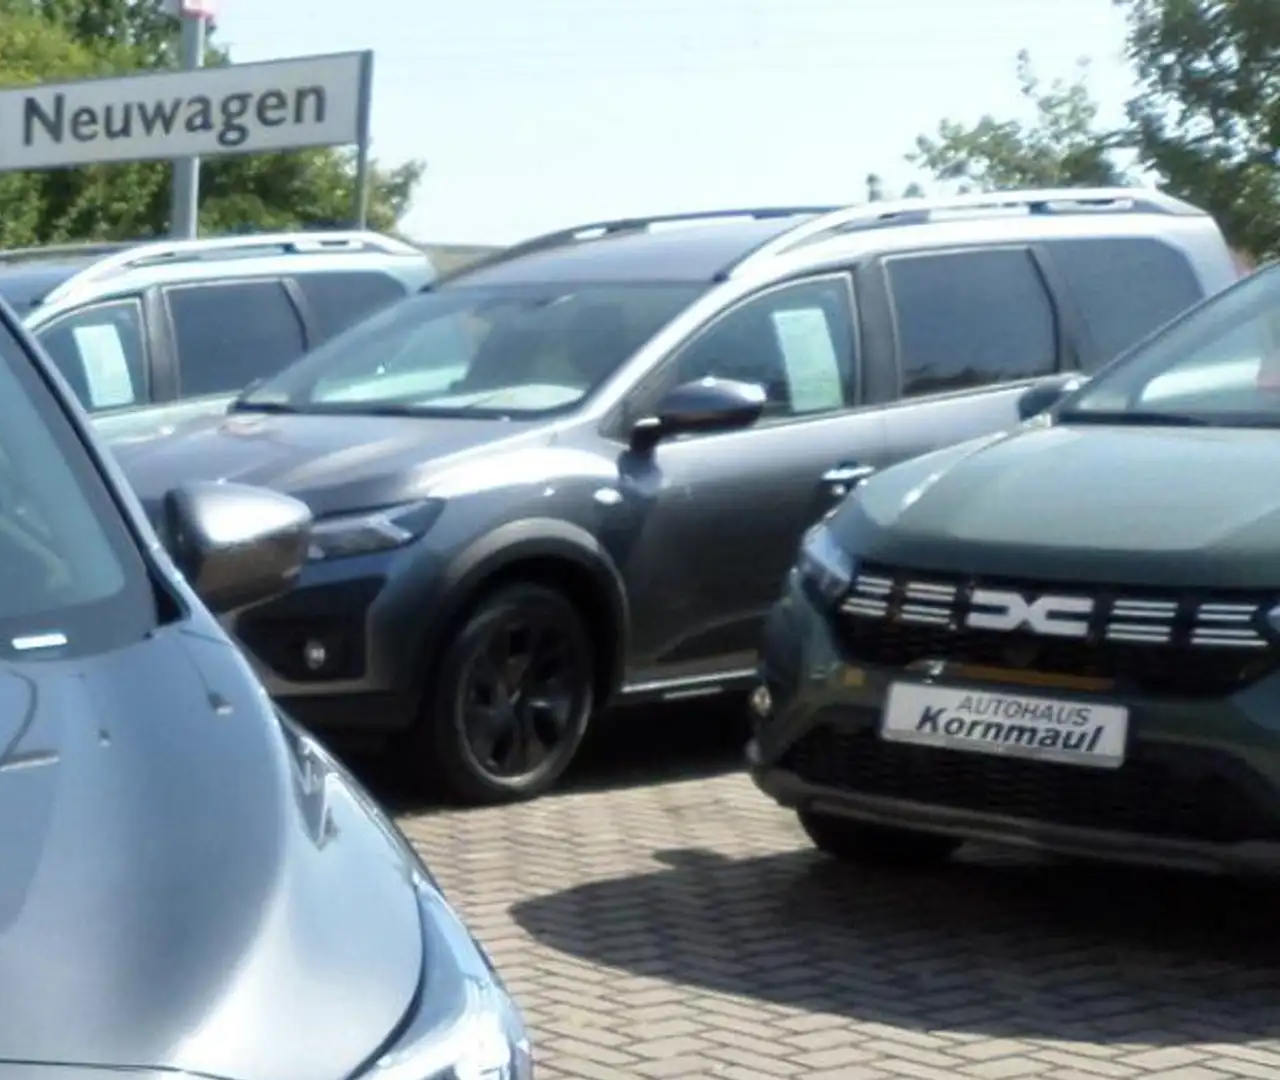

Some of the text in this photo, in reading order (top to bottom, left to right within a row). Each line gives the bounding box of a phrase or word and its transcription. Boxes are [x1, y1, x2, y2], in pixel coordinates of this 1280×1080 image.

[22, 83, 326, 146] Neuwagen
[914, 705, 1105, 752] Kornmaul
[956, 696, 1092, 727] AUTOHAUS
